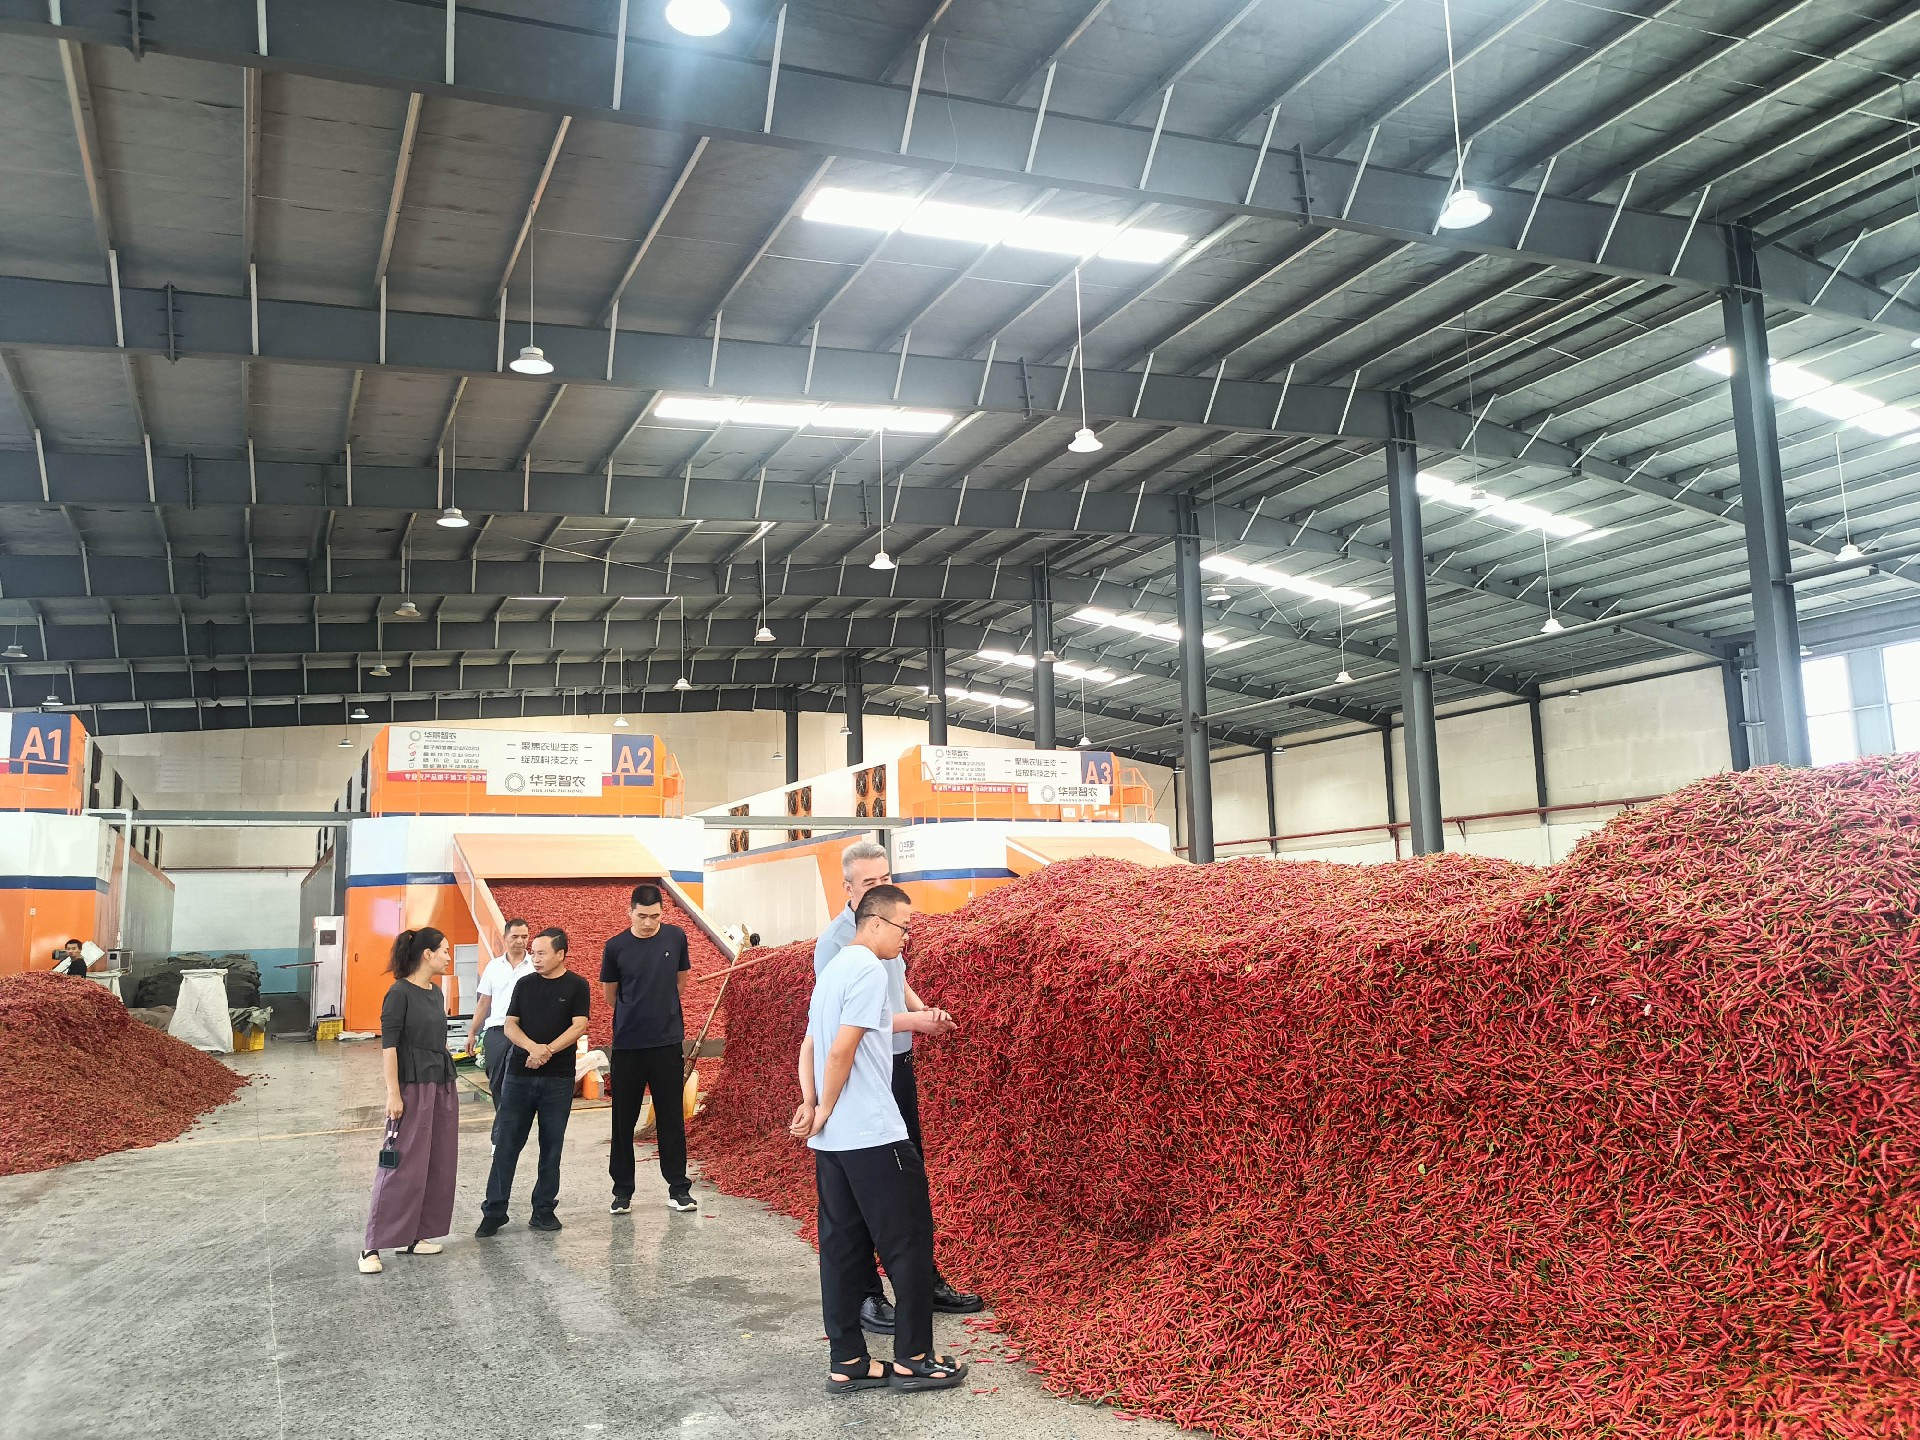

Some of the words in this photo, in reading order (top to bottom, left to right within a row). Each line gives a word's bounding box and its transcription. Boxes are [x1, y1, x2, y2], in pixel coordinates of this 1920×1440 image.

[20, 726, 62, 761] A1
[521, 741, 579, 752] 聚焦农业生态
[521, 755, 578, 765] 绽放科技之光
[615, 745, 652, 774] A2
[1085, 760, 1112, 784] A3
[529, 774, 586, 787] 华景智农
[1058, 786, 1098, 797] 华景智农
